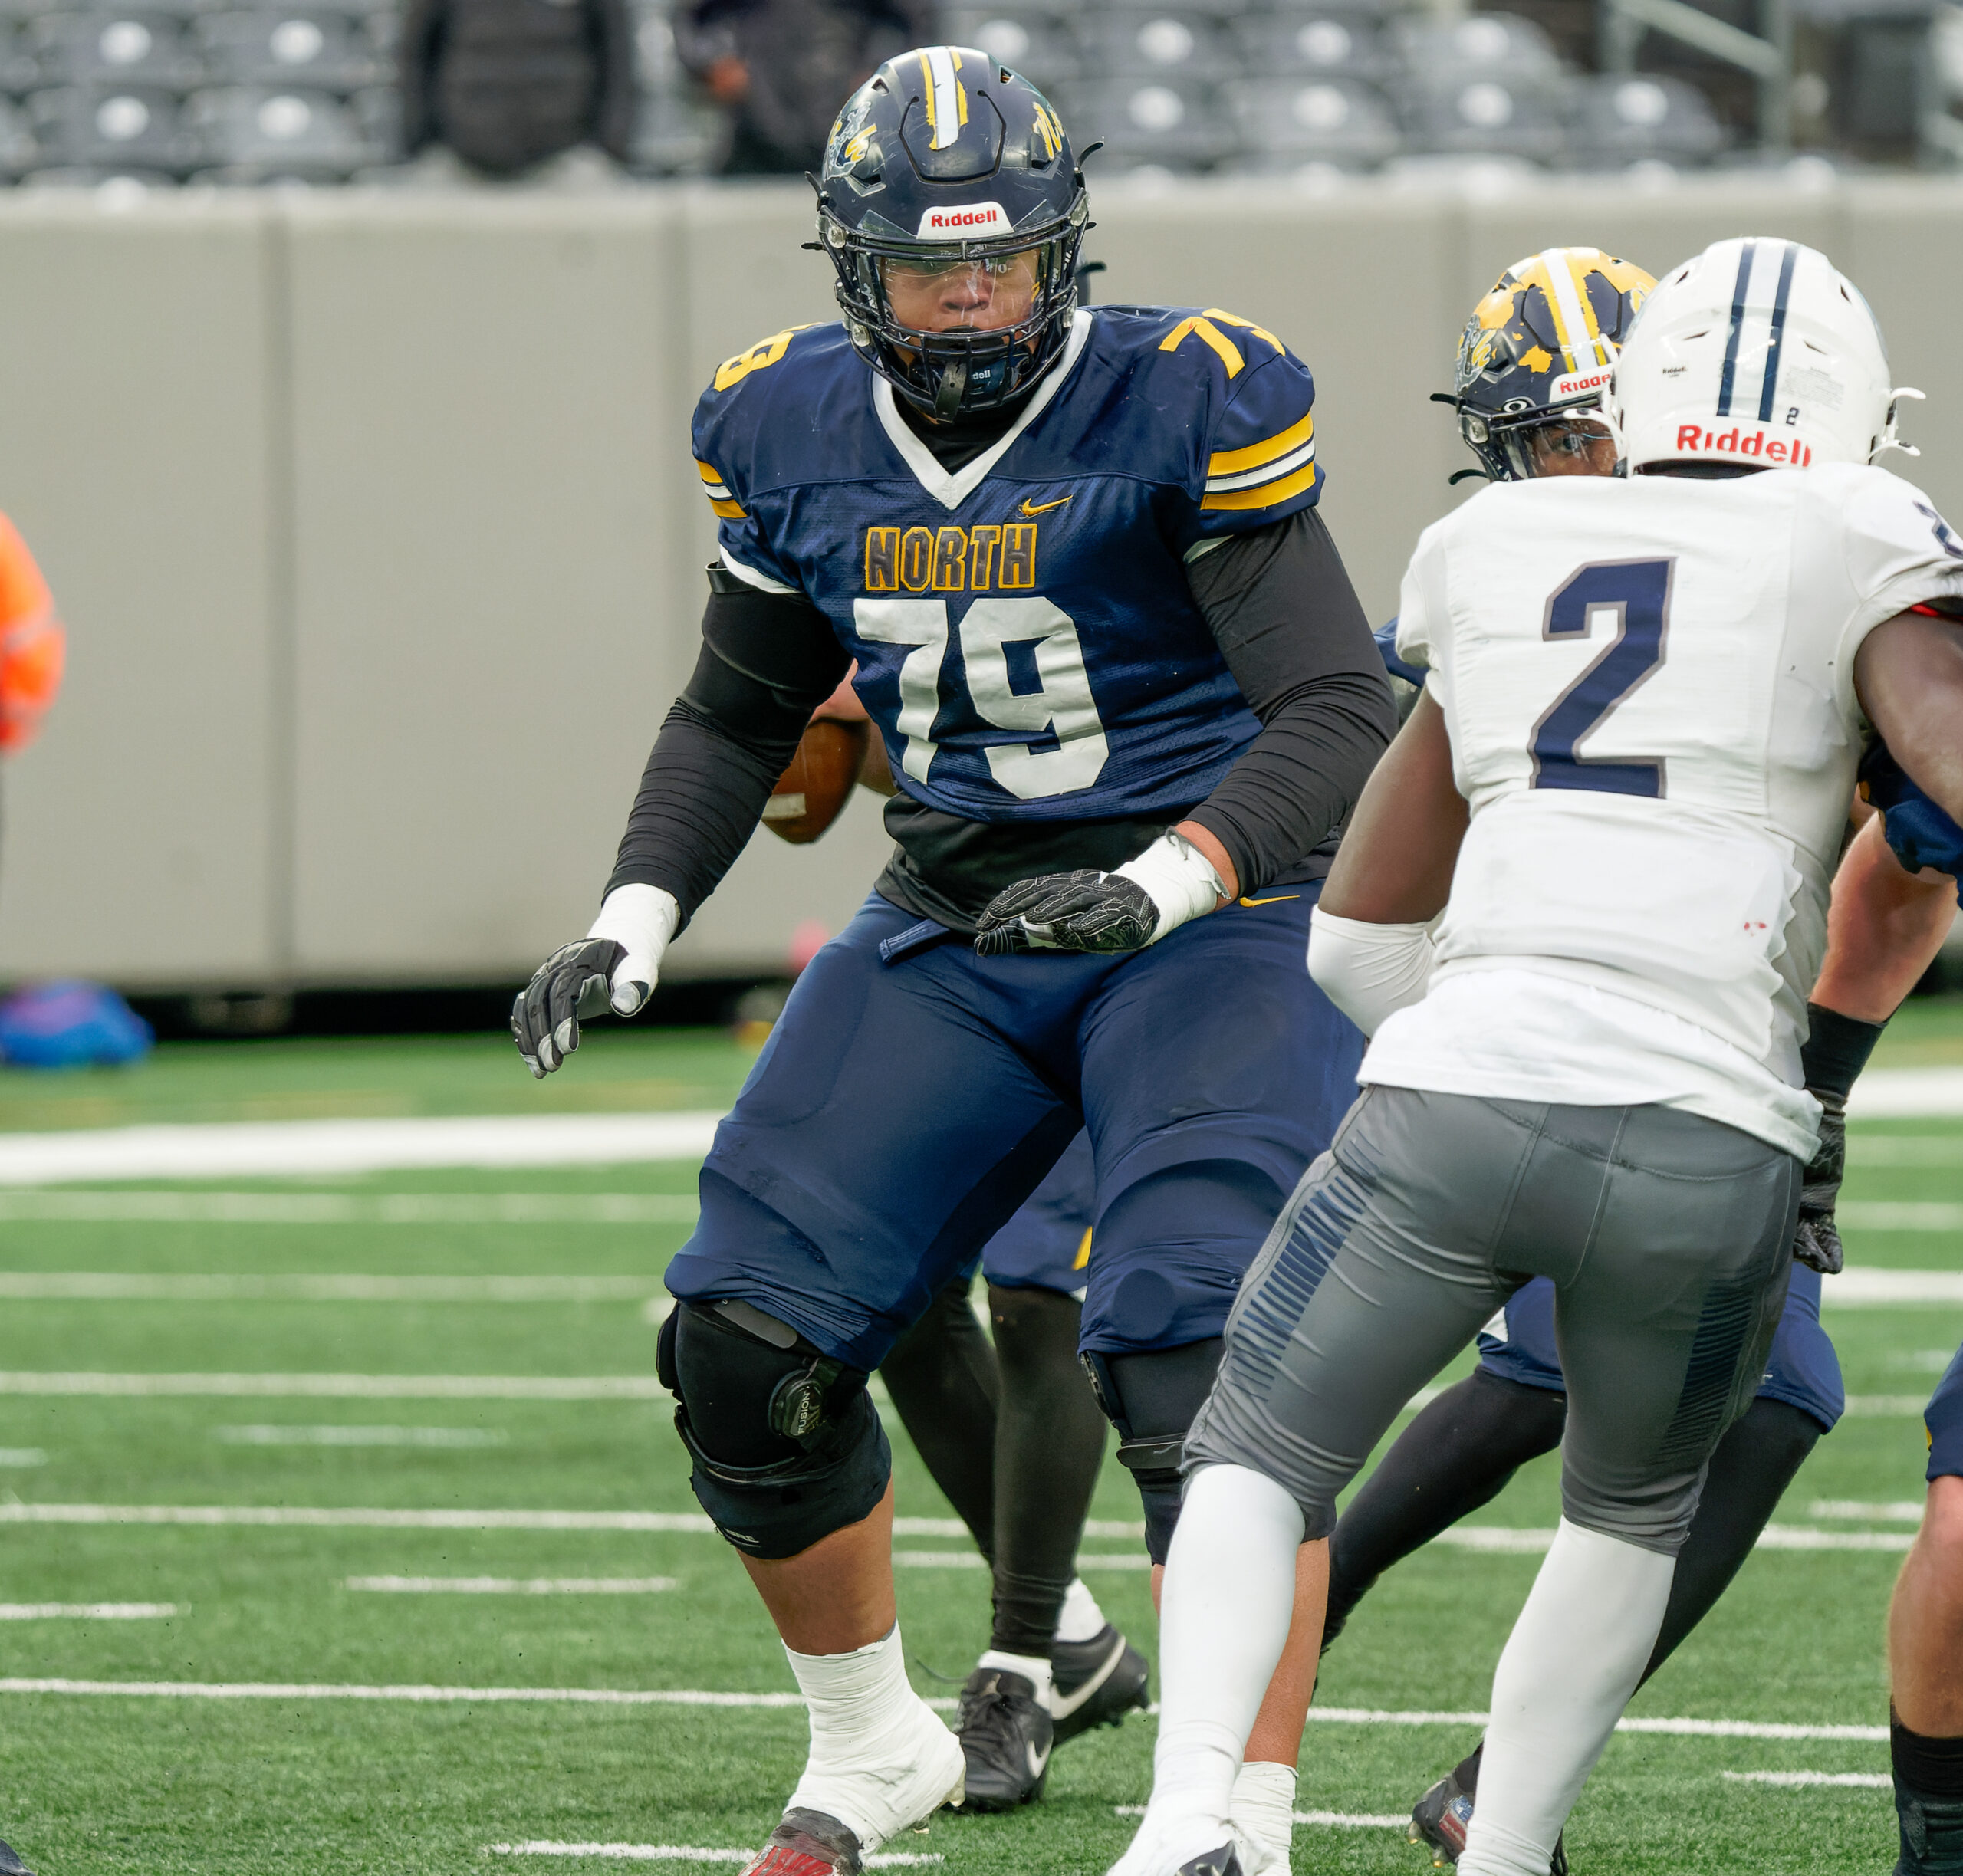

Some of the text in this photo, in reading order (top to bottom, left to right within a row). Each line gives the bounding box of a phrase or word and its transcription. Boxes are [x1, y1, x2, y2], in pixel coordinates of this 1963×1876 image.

[931, 209, 998, 228] Riddell
[1560, 373, 1611, 394] Ridde
[1785, 406, 1800, 426] 2
[1677, 425, 1812, 468] Riddell
[866, 524, 1037, 592] NORTH
[853, 596, 1110, 800] 79
[1528, 556, 1678, 798] 2
[797, 1391, 811, 1434] FUSION
